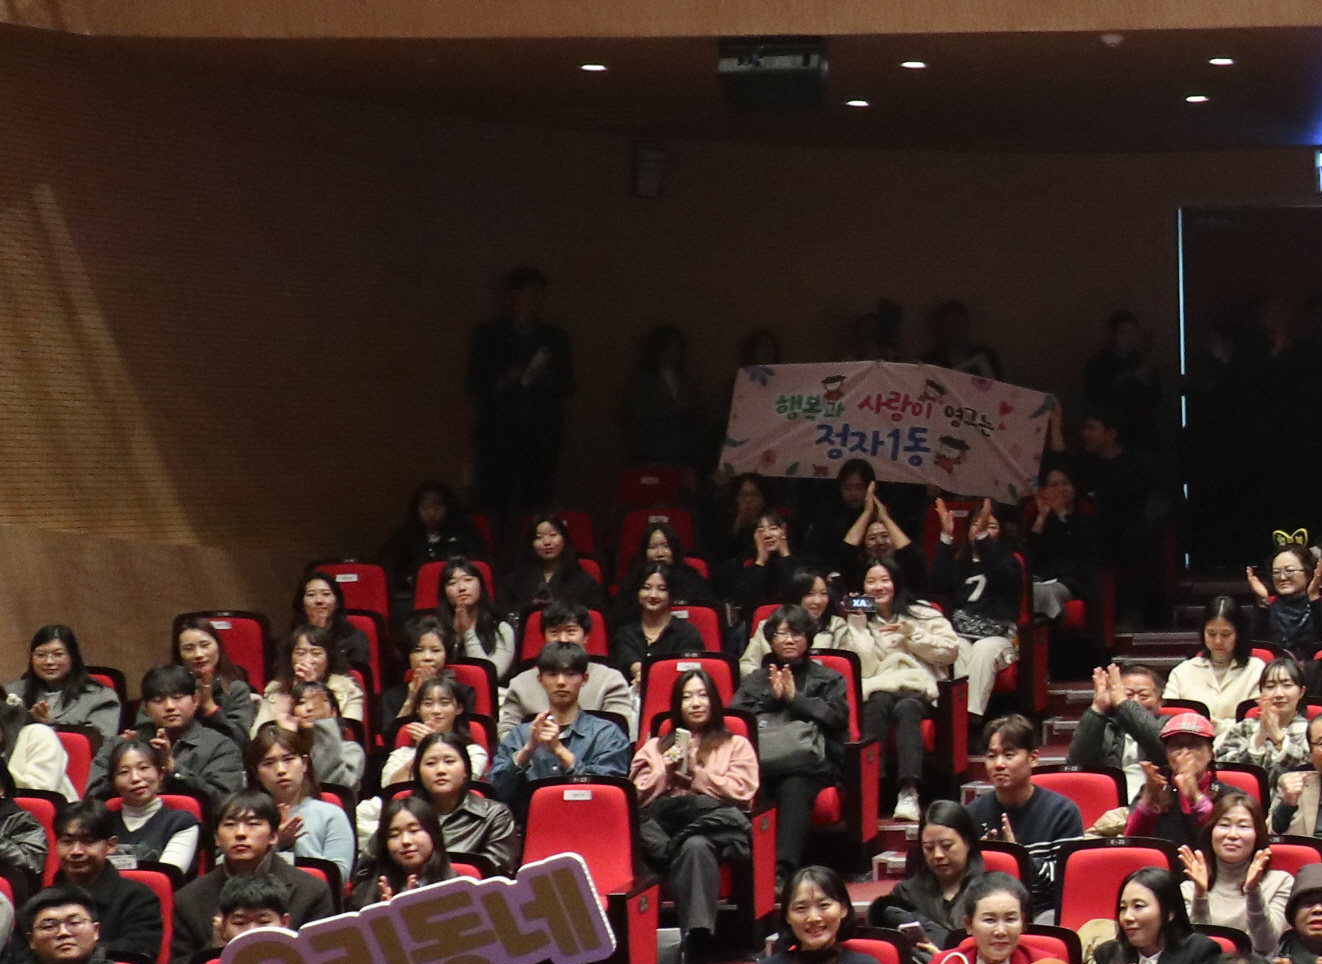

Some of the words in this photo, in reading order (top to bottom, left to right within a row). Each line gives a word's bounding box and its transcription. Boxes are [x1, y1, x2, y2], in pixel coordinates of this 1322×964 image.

[775, 395, 845, 421] 행복과
[857, 391, 933, 422] 사랑이
[815, 423, 931, 467] 정자1동
